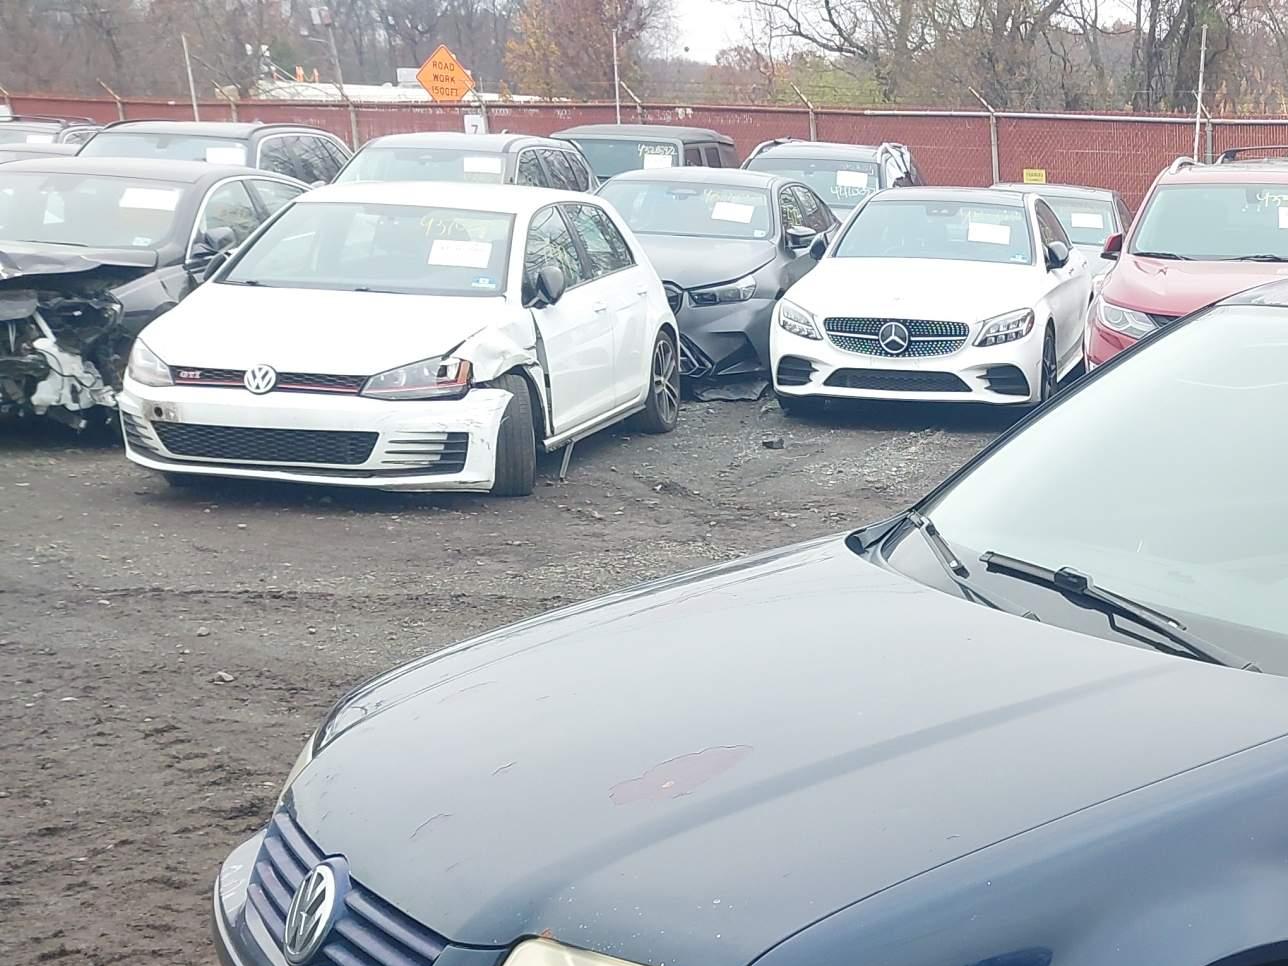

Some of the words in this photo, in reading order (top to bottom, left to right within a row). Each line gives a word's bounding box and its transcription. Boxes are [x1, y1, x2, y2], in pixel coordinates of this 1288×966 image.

[432, 60, 455, 72] ROAD
[432, 73, 456, 84] WORK
[179, 370, 201, 379] GTI
